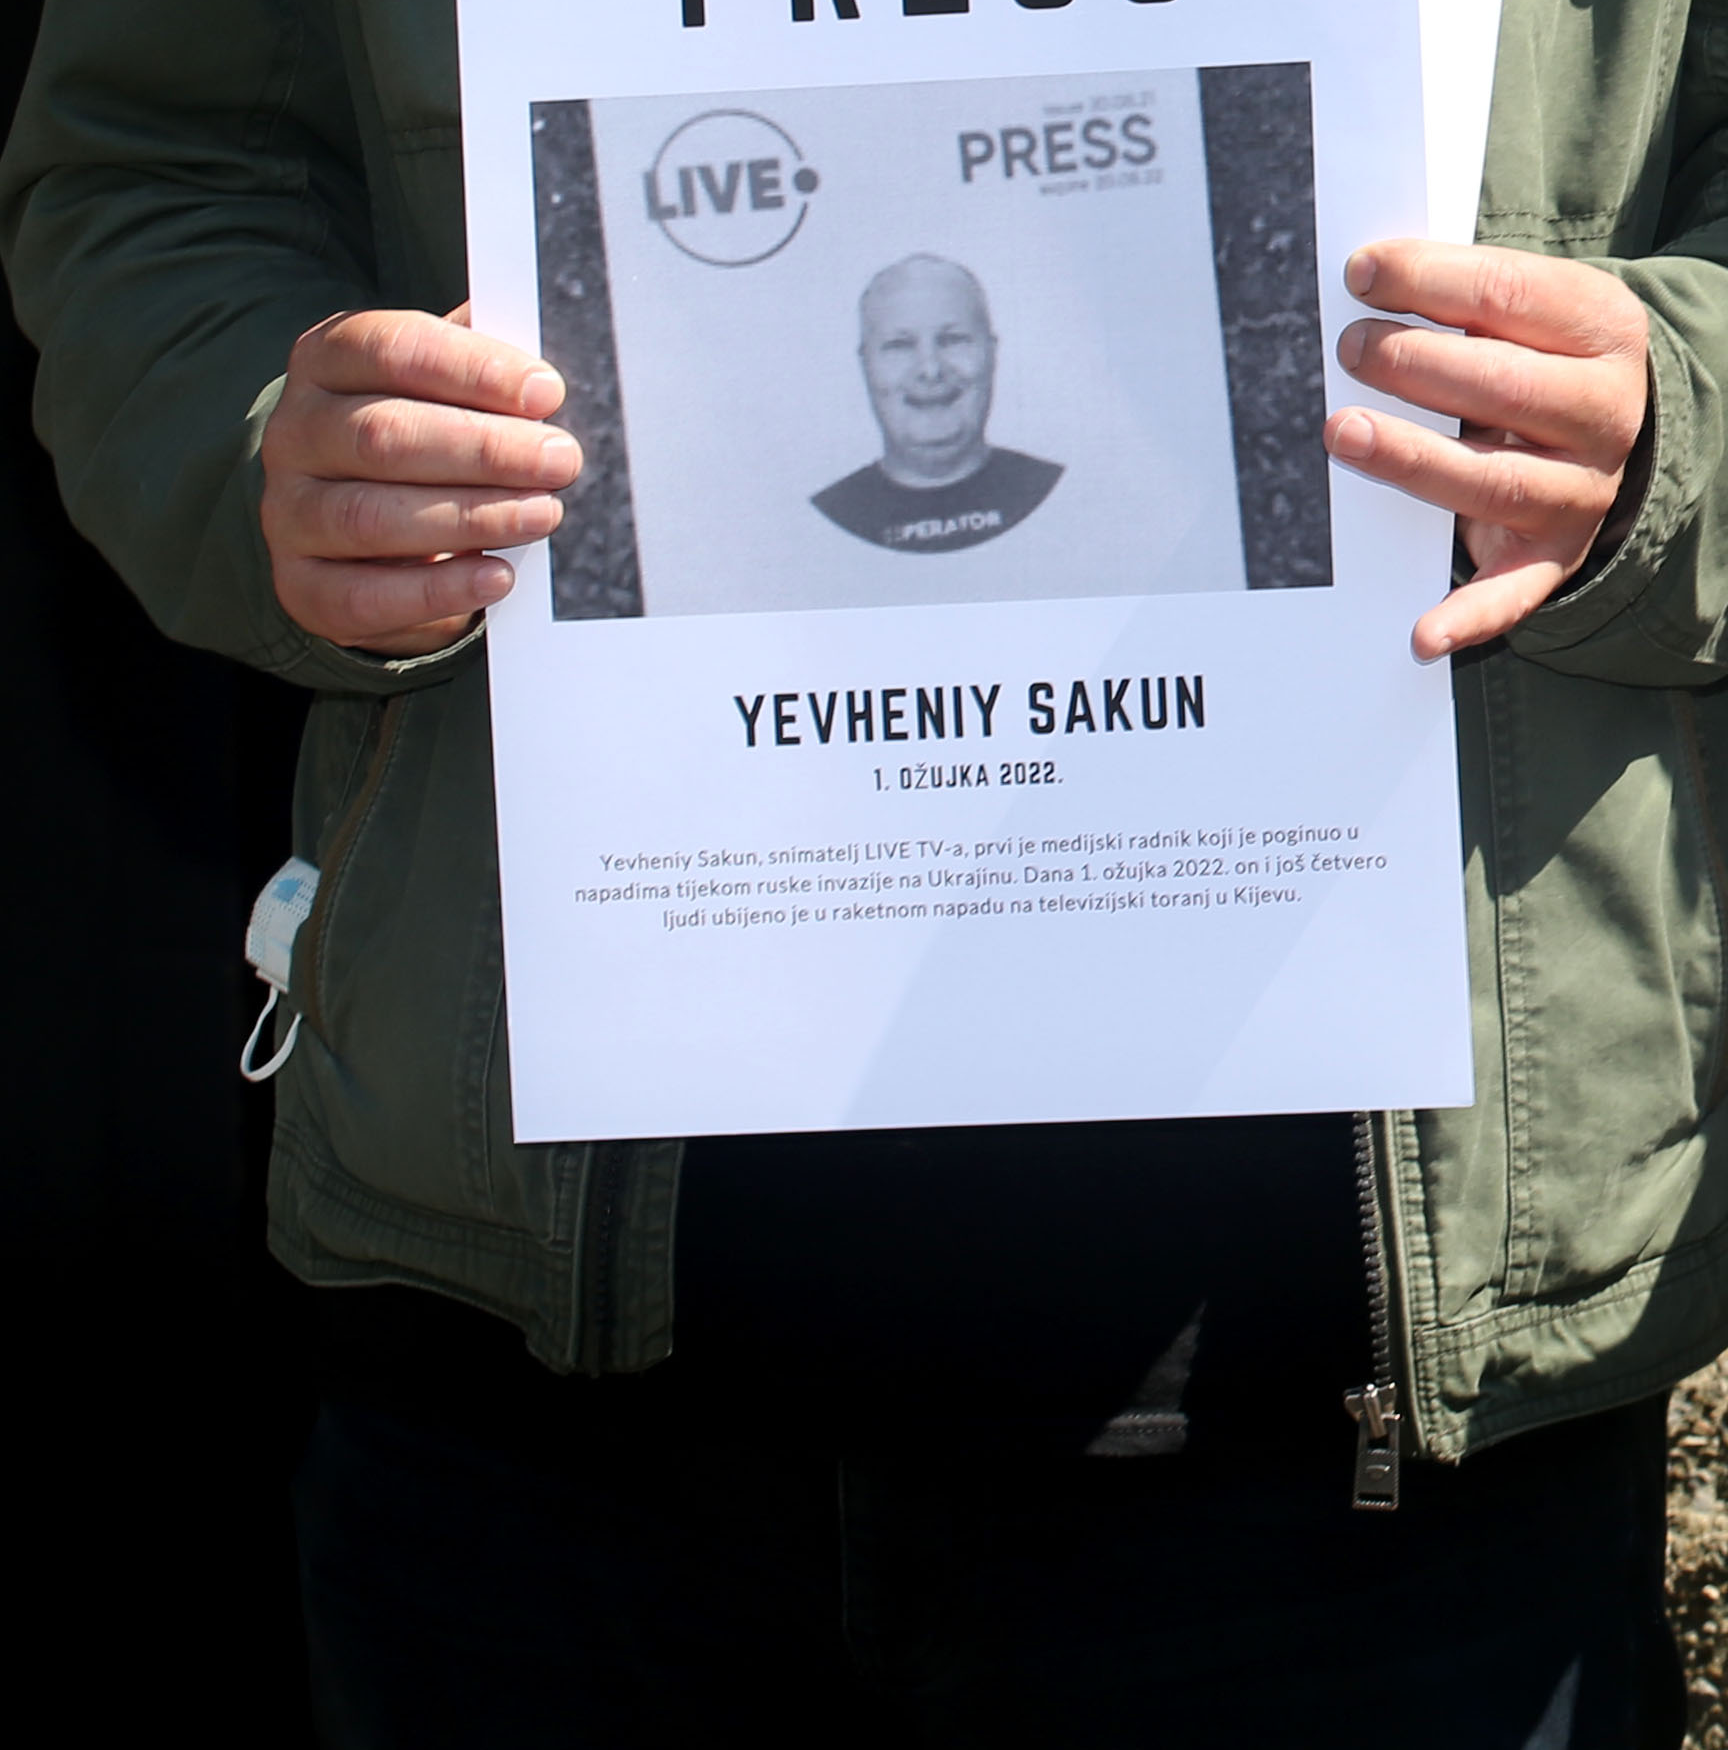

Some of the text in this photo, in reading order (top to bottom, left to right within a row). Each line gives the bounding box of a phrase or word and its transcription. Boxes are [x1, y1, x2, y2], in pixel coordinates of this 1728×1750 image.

[958, 113, 1157, 183] PRESS
[644, 158, 785, 220] LIVE
[732, 674, 1206, 749] YEVHENIY SAKUN
[873, 760, 1064, 792] 1. OŽUJKA 2022.
[598, 823, 1360, 873] Yevheniy Sakun, snimatelj LIVE TV-a, prvi je medijski radnik koji je poginuo u
[574, 851, 1388, 906] napadima tijekom ruske invazije na Ukrajinu. Dana 1. ožujka 2022. on i još četvero
[662, 885, 1303, 933] ljudi ubijeno je u raketnom napadu na televizijski toranj u Kijevu.
